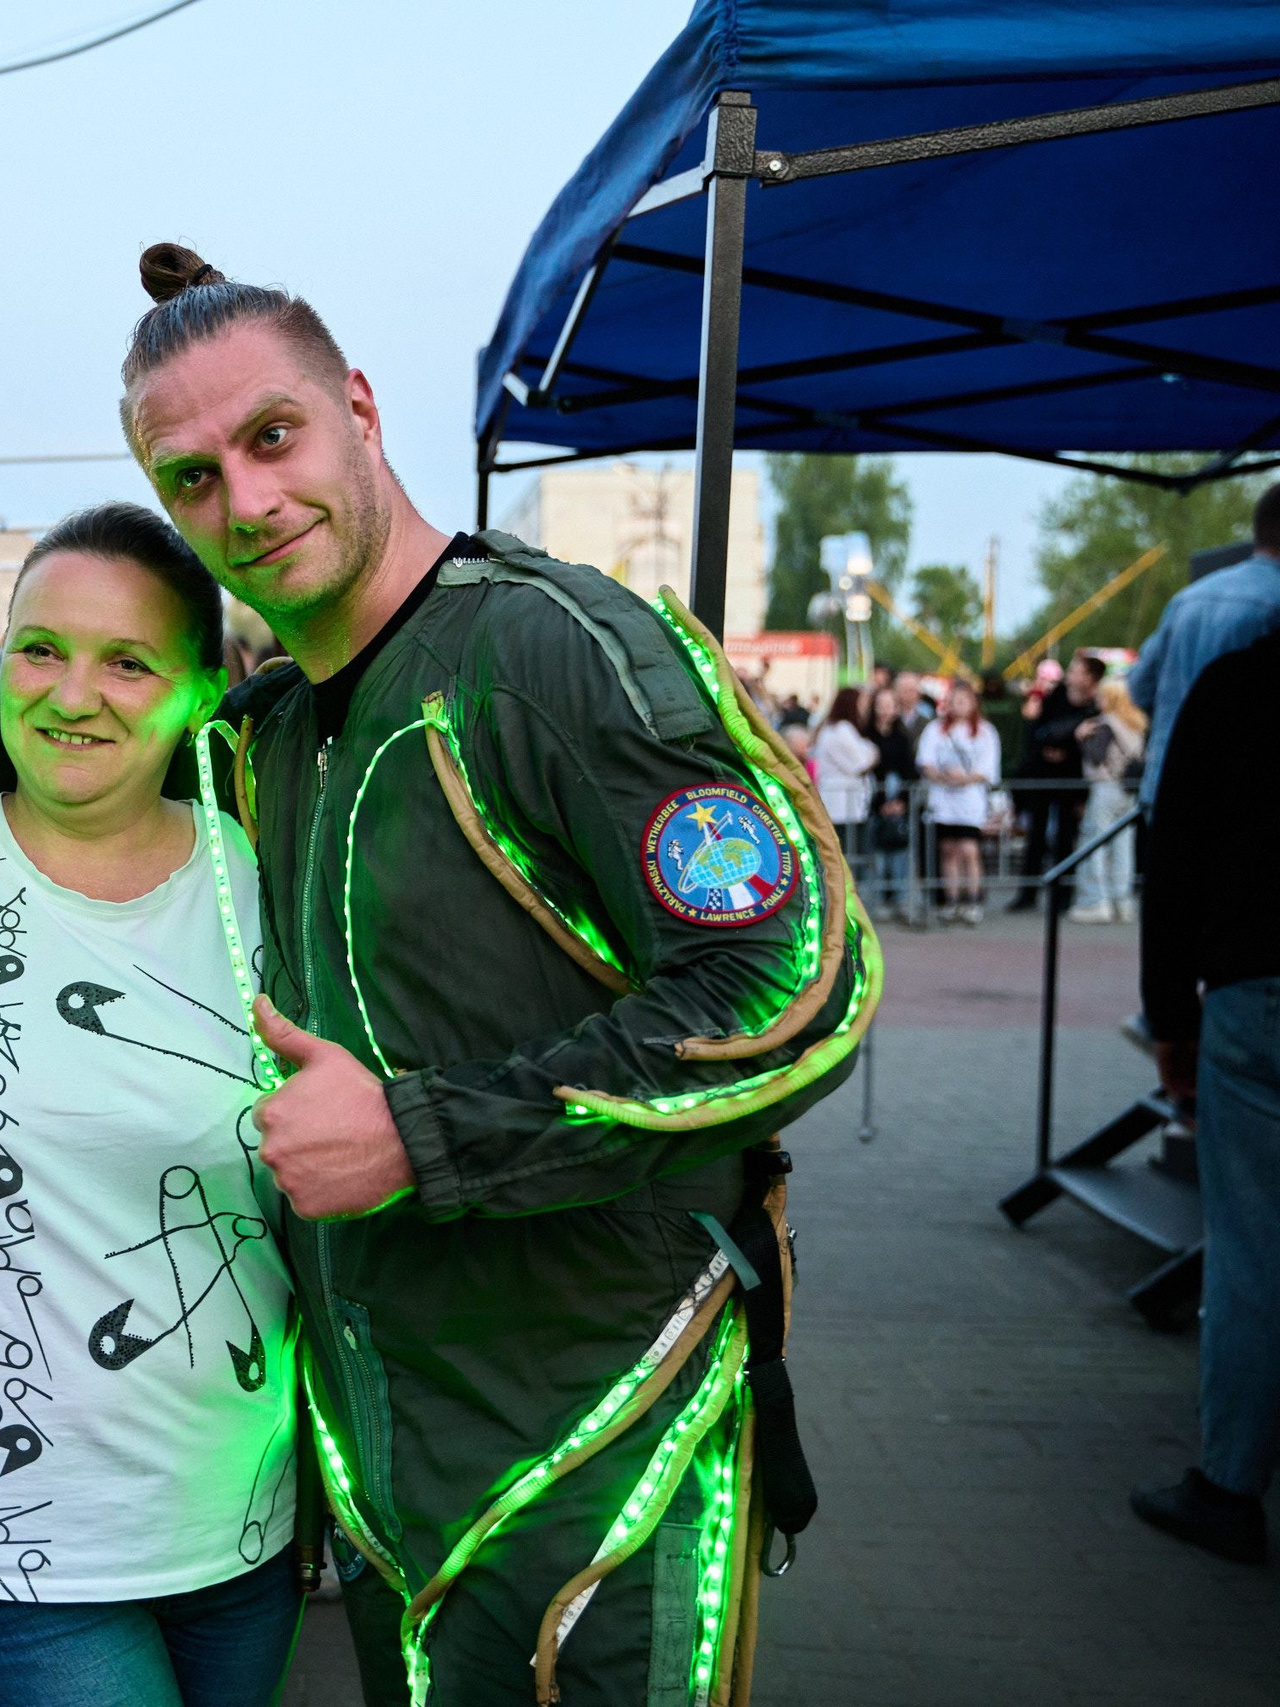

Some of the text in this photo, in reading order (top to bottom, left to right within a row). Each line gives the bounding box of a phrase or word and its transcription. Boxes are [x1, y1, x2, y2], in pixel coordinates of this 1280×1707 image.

[646, 787, 792, 877] WETHERBEE BLOOMFIELD CHRETIEN TITOV
[646, 860, 687, 913] PARAZYNSKI
[700, 887, 785, 921] LAWRENCE FOALE
